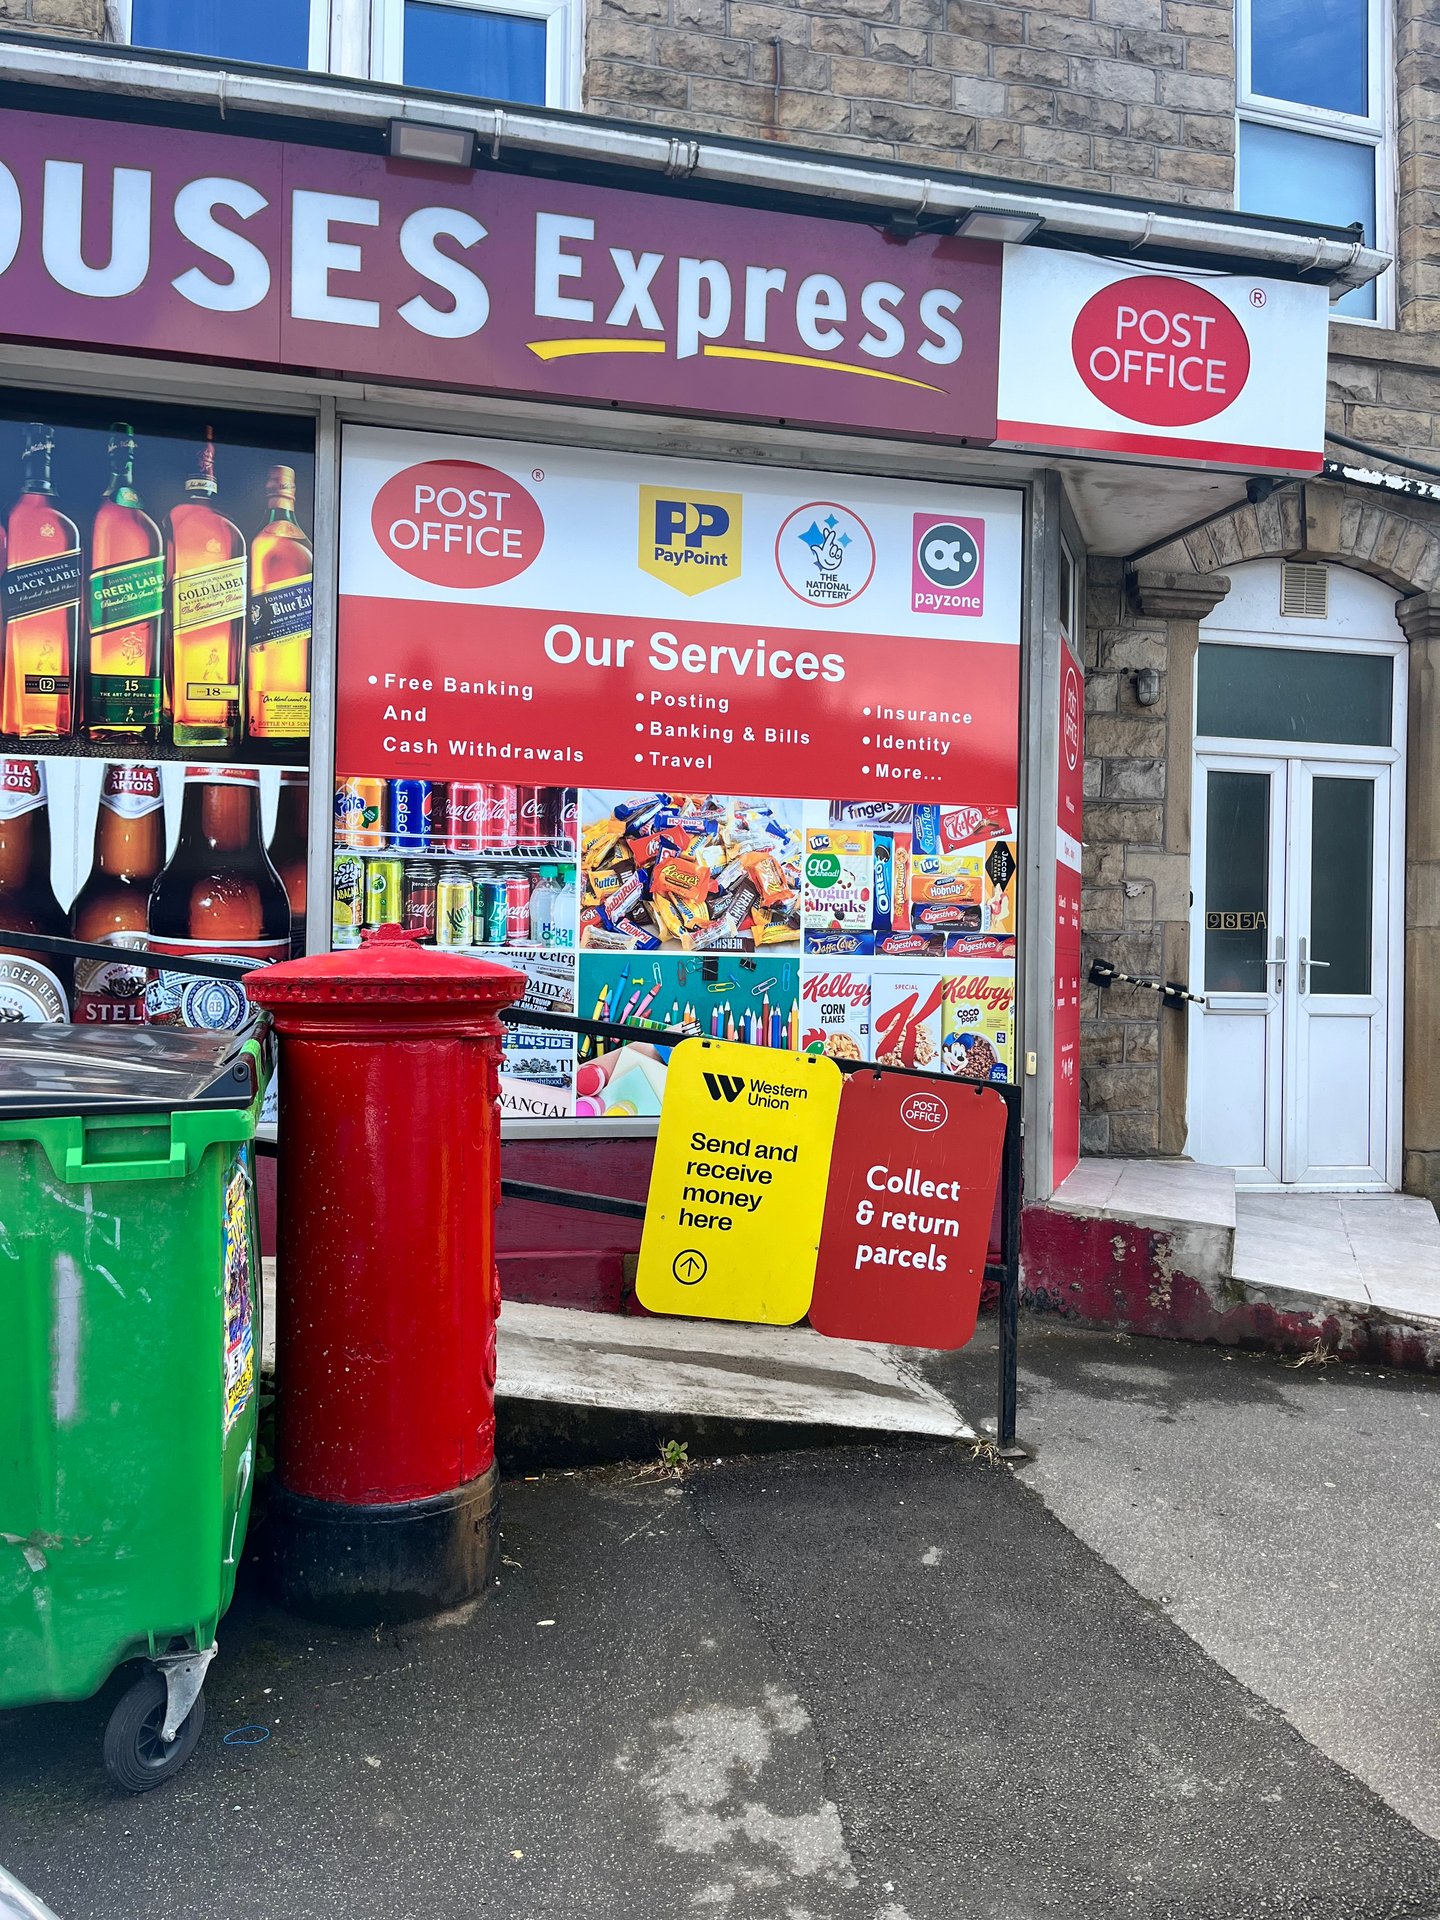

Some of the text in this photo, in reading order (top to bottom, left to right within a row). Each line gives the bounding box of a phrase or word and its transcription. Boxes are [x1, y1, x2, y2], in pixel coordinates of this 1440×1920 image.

[0, 159, 964, 365] USES Express
[1116, 305, 1216, 350] POST
[1089, 345, 1227, 394] OFFICE
[414, 484, 511, 521] POST
[388, 518, 523, 559] OFFICE
[654, 547, 729, 567] PayPoint
[7, 575, 46, 595] BLACK
[805, 580, 852, 592] NATIONAL
[819, 573, 839, 583] THE
[94, 583, 133, 601] GREEN
[178, 585, 211, 602] GOLD
[264, 592, 294, 605] JOHNNIE
[808, 589, 850, 600] LOTTERY
[914, 592, 981, 610] payzone
[270, 602, 297, 617] Blue
[543, 623, 846, 683] Our Services
[42, 680, 52, 690] 12
[124, 679, 139, 692] 15
[205, 687, 221, 696] 18
[384, 673, 534, 701] Free Banking
[650, 690, 730, 713] Posting
[383, 704, 428, 723] And
[876, 705, 973, 725] Insurance
[649, 721, 811, 745] Banking & Bills
[383, 736, 585, 763] Cash Withdrawals
[876, 734, 951, 755] Identity
[0, 763, 32, 777] LLA
[649, 751, 714, 770] Travel
[112, 770, 154, 782] STELLA
[876, 763, 943, 781] More...
[111, 780, 154, 792] ARTOIS
[396, 789, 412, 834] pepsi
[847, 801, 894, 820] fingers
[922, 806, 934, 846] Rich Tea
[951, 809, 980, 838] KitKat
[661, 863, 700, 887] Reese's
[807, 858, 832, 877] go
[875, 862, 890, 913] OREO
[896, 862, 906, 904] Maryland
[930, 884, 964, 897] Hobnobs
[809, 886, 859, 902] yogurt
[815, 899, 866, 913] breaks
[925, 909, 958, 922] Digestives
[619, 921, 651, 942] CRUNCH
[808, 936, 857, 954] Jaffa Cakes
[886, 940, 922, 951] Digestives
[958, 941, 996, 953] Digestives
[525, 978, 565, 998] DAILY
[894, 983, 919, 991] SPECIAL
[38, 982, 60, 1014] BEER
[820, 1003, 846, 1016] CORN
[820, 1014, 846, 1025] FLAKES
[519, 1035, 571, 1049] INSIDE
[991, 1071, 1007, 1080] 30%
[750, 1078, 808, 1100] Western
[748, 1092, 790, 1111] Union
[912, 1099, 939, 1113] POST
[905, 1109, 941, 1123] OFFICE
[690, 1131, 799, 1163] Send and
[686, 1160, 774, 1185] receive
[866, 1165, 961, 1202] Collect
[682, 1186, 763, 1213] money
[678, 1207, 733, 1231] here
[855, 1199, 960, 1238] & return
[854, 1243, 948, 1272] parcels
